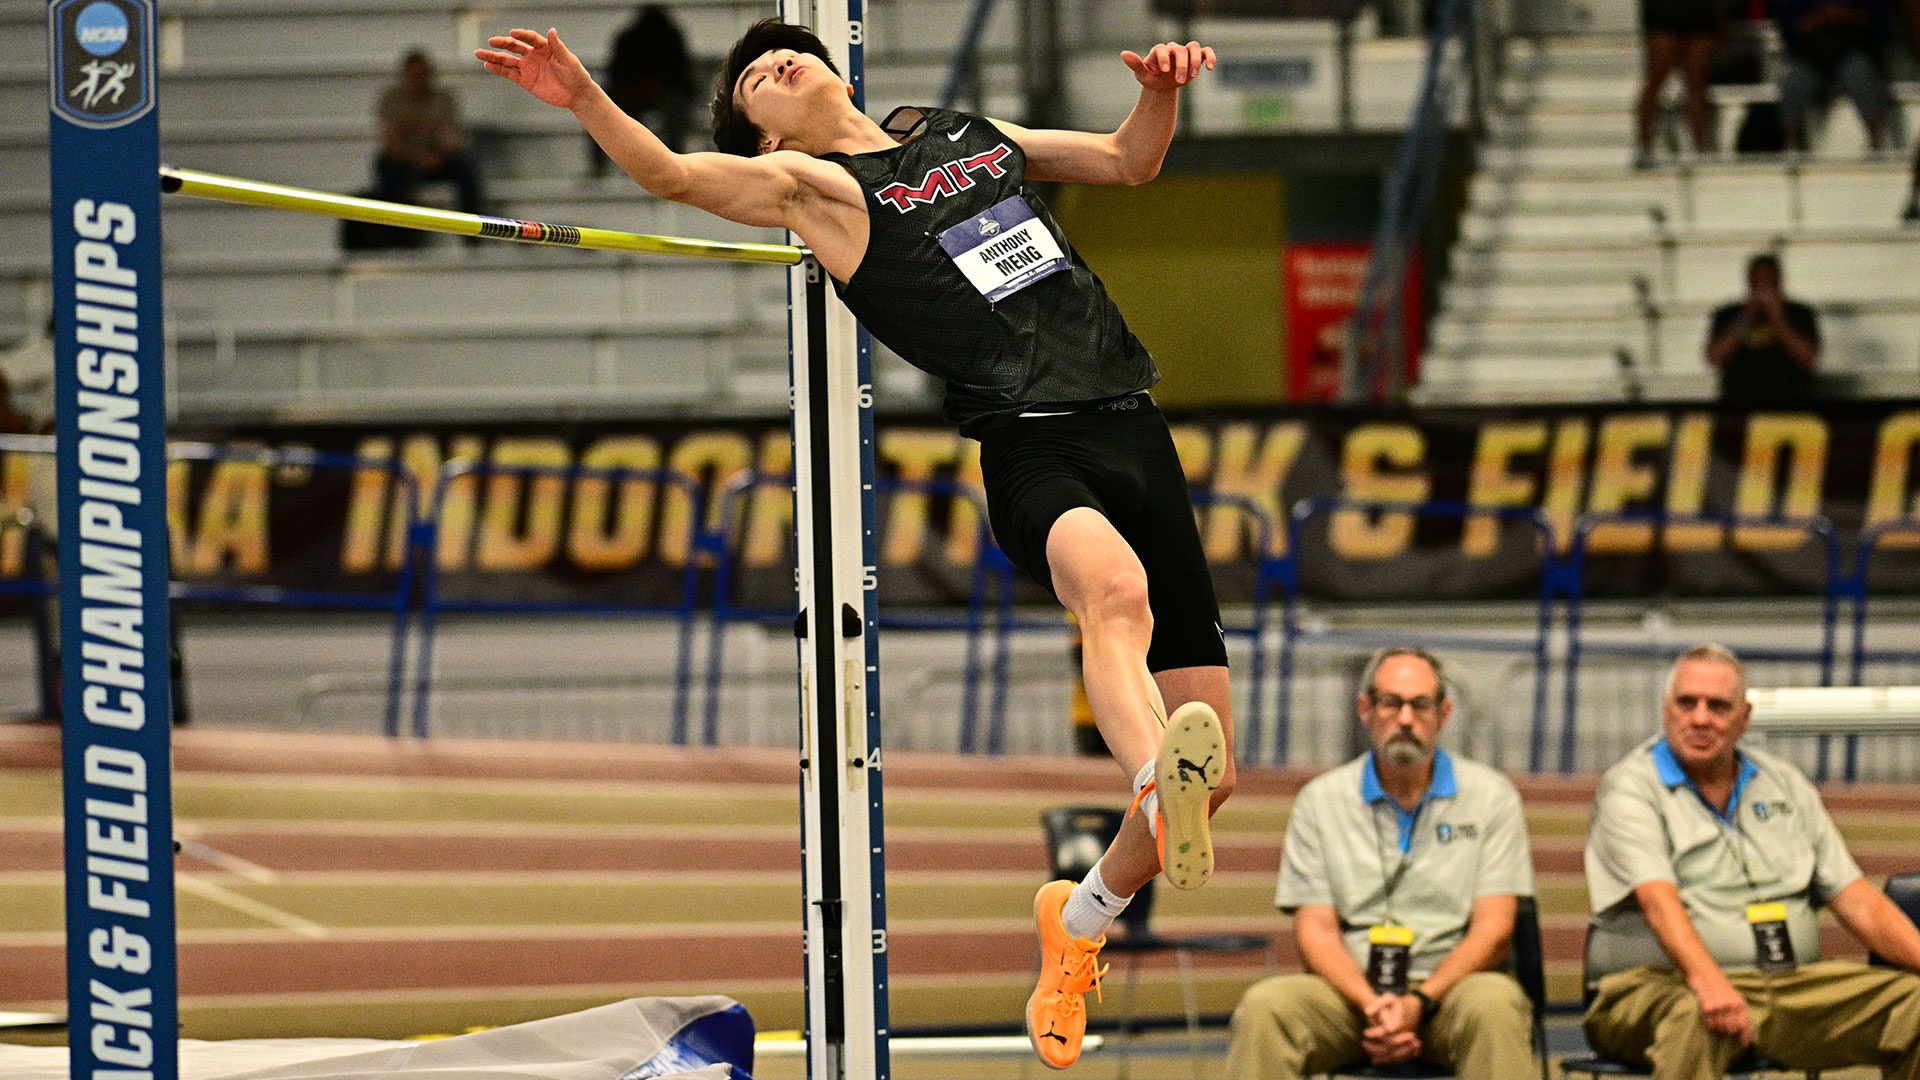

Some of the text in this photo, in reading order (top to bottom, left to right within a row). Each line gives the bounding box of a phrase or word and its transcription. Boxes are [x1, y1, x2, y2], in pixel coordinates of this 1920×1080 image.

[81, 26, 128, 42] NCAA
[848, 21, 863, 45] 8
[875, 143, 1013, 214] MIT
[979, 228, 1033, 264] ANTHONY
[994, 245, 1043, 277] MENG
[858, 384, 873, 409] 6
[1098, 396, 1139, 410] PRO
[73, 198, 146, 731] CHAMPIONSHIPS
[1327, 423, 1431, 560] &
[1461, 412, 1830, 560] FIELD
[863, 566, 878, 591] 5
[866, 747, 882, 772] 4
[84, 744, 151, 918] FIELD
[88, 925, 152, 975] &
[872, 929, 887, 953] 3
